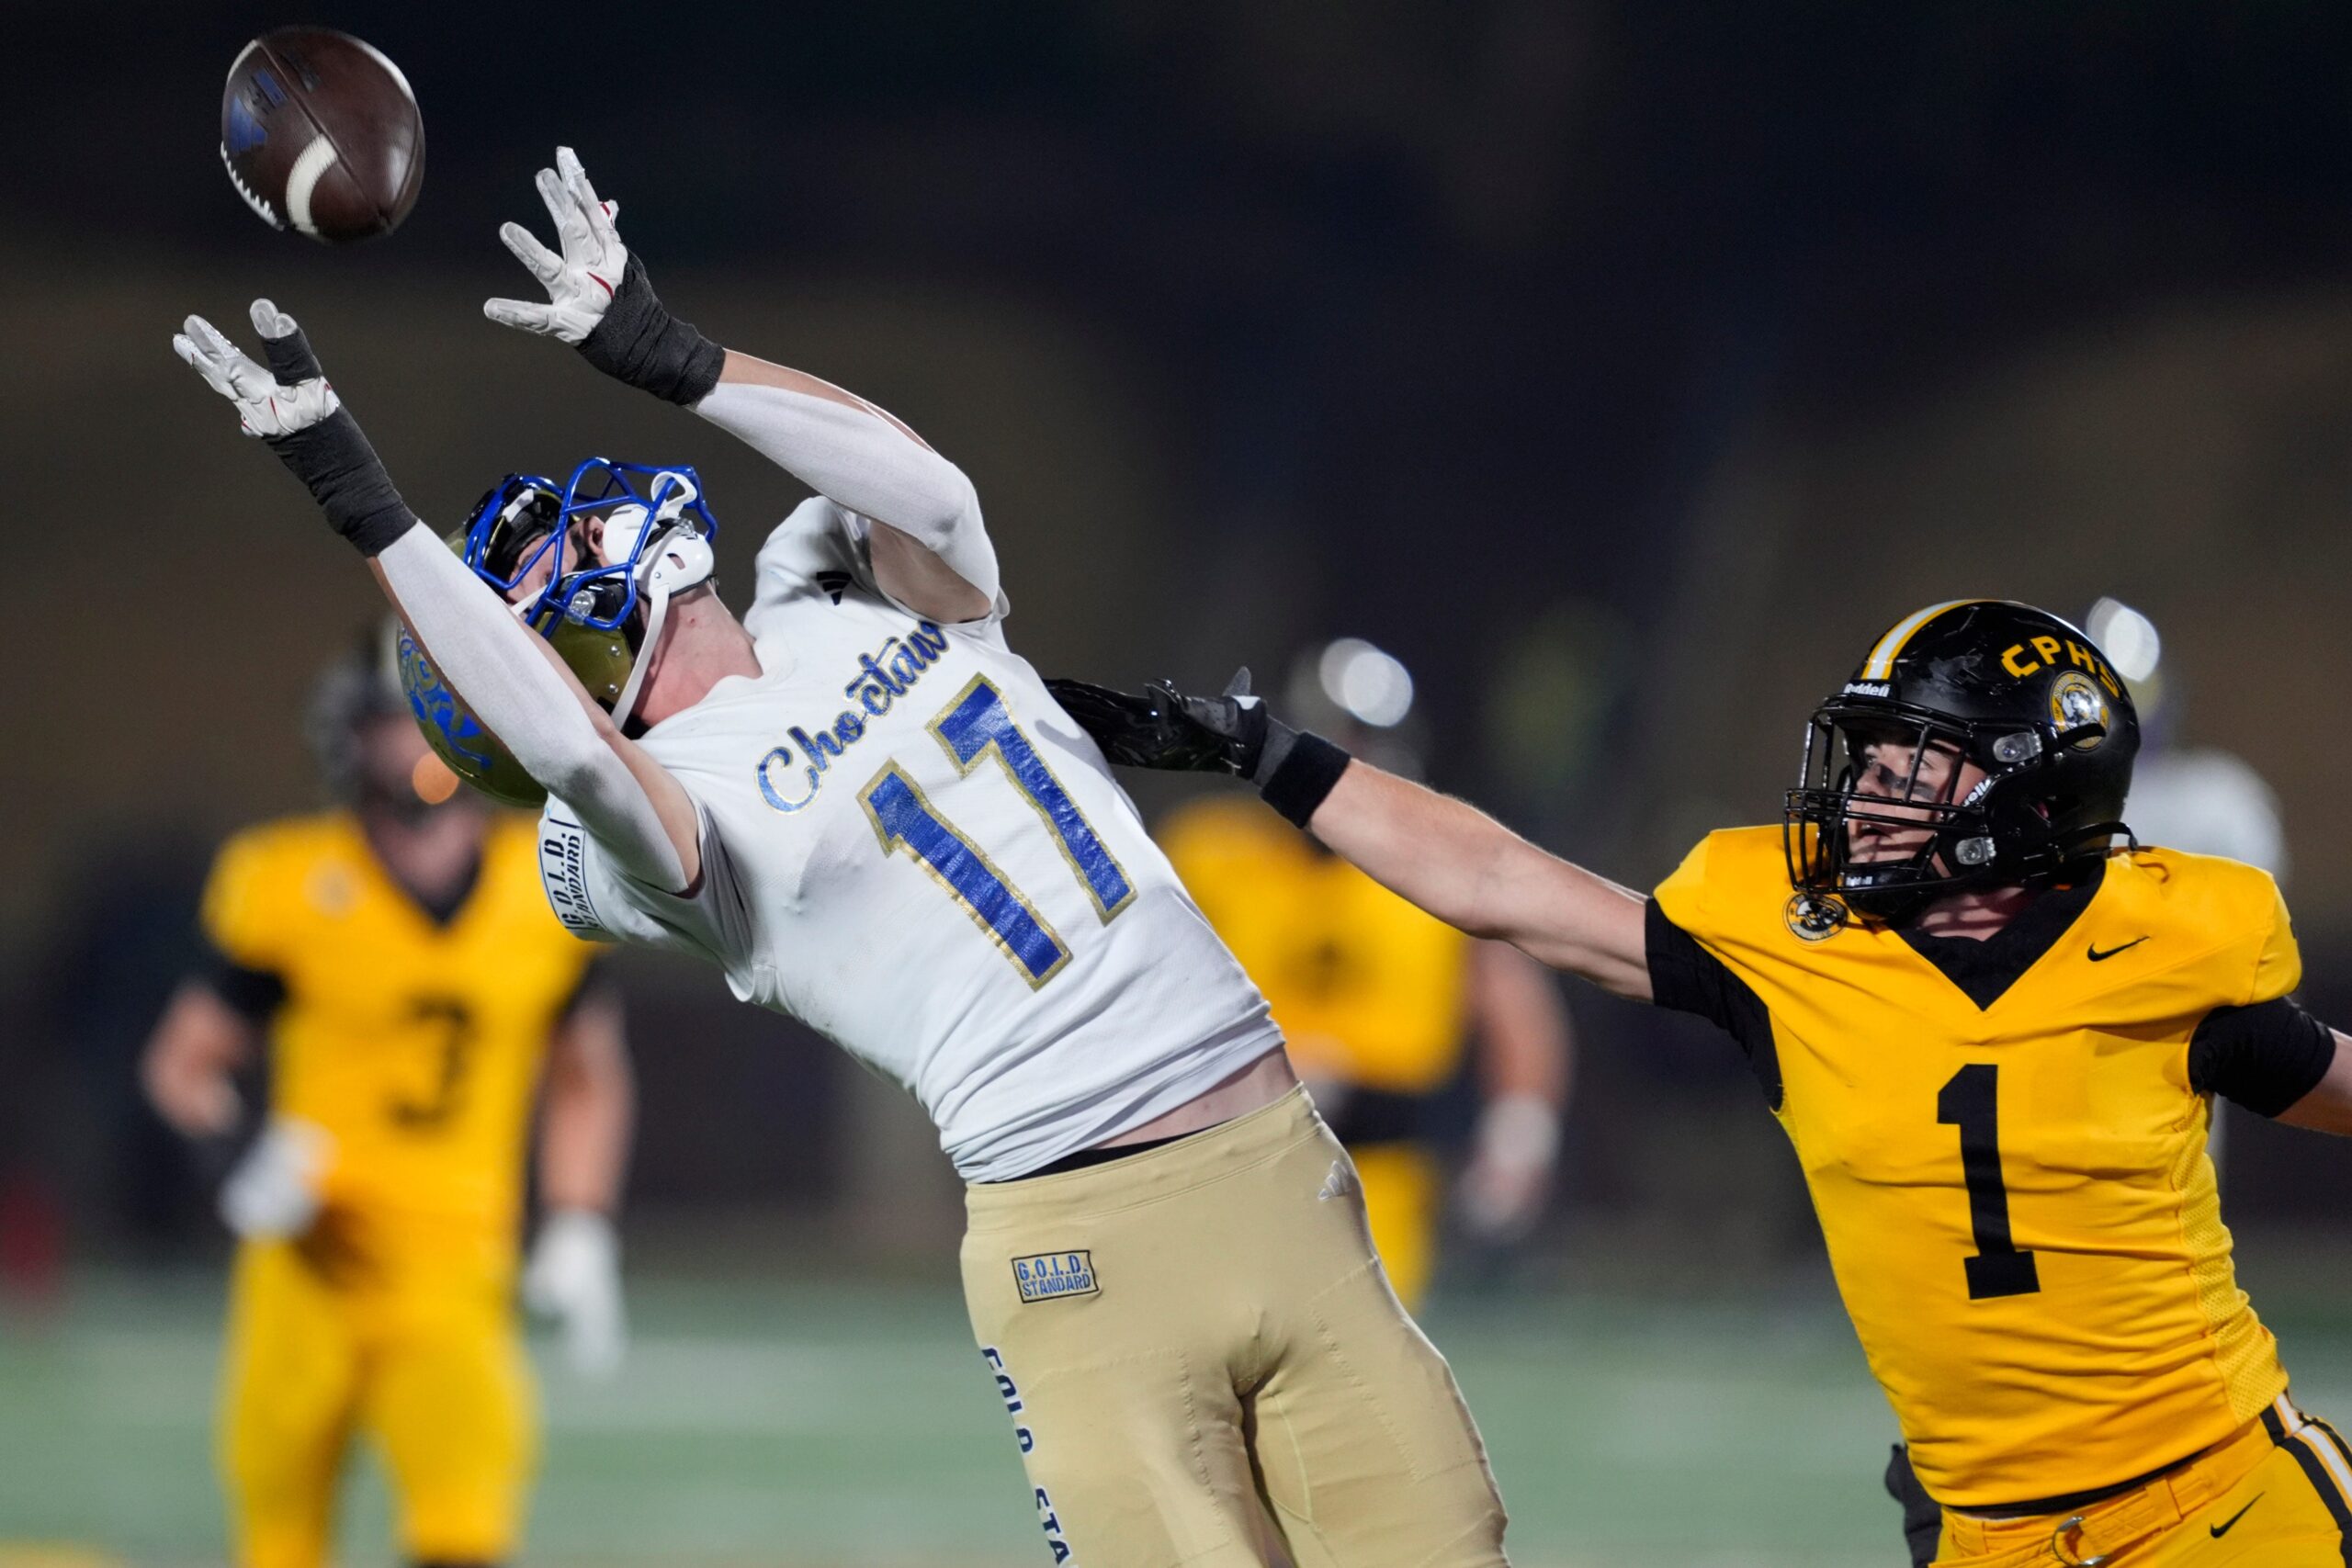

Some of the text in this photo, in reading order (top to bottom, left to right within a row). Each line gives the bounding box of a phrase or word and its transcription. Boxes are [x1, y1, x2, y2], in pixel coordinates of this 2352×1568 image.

[2001, 635, 2120, 699] CPHS
[754, 621, 950, 816] Choctaw
[855, 671, 1138, 992] 17
[544, 832, 585, 926] G.O.L.D.
[567, 835, 598, 928] STANDARD
[1937, 1063, 2041, 1300] 1
[1017, 1254, 1089, 1281] G.O.L.D.
[1022, 1273, 1091, 1297] STANDARD
